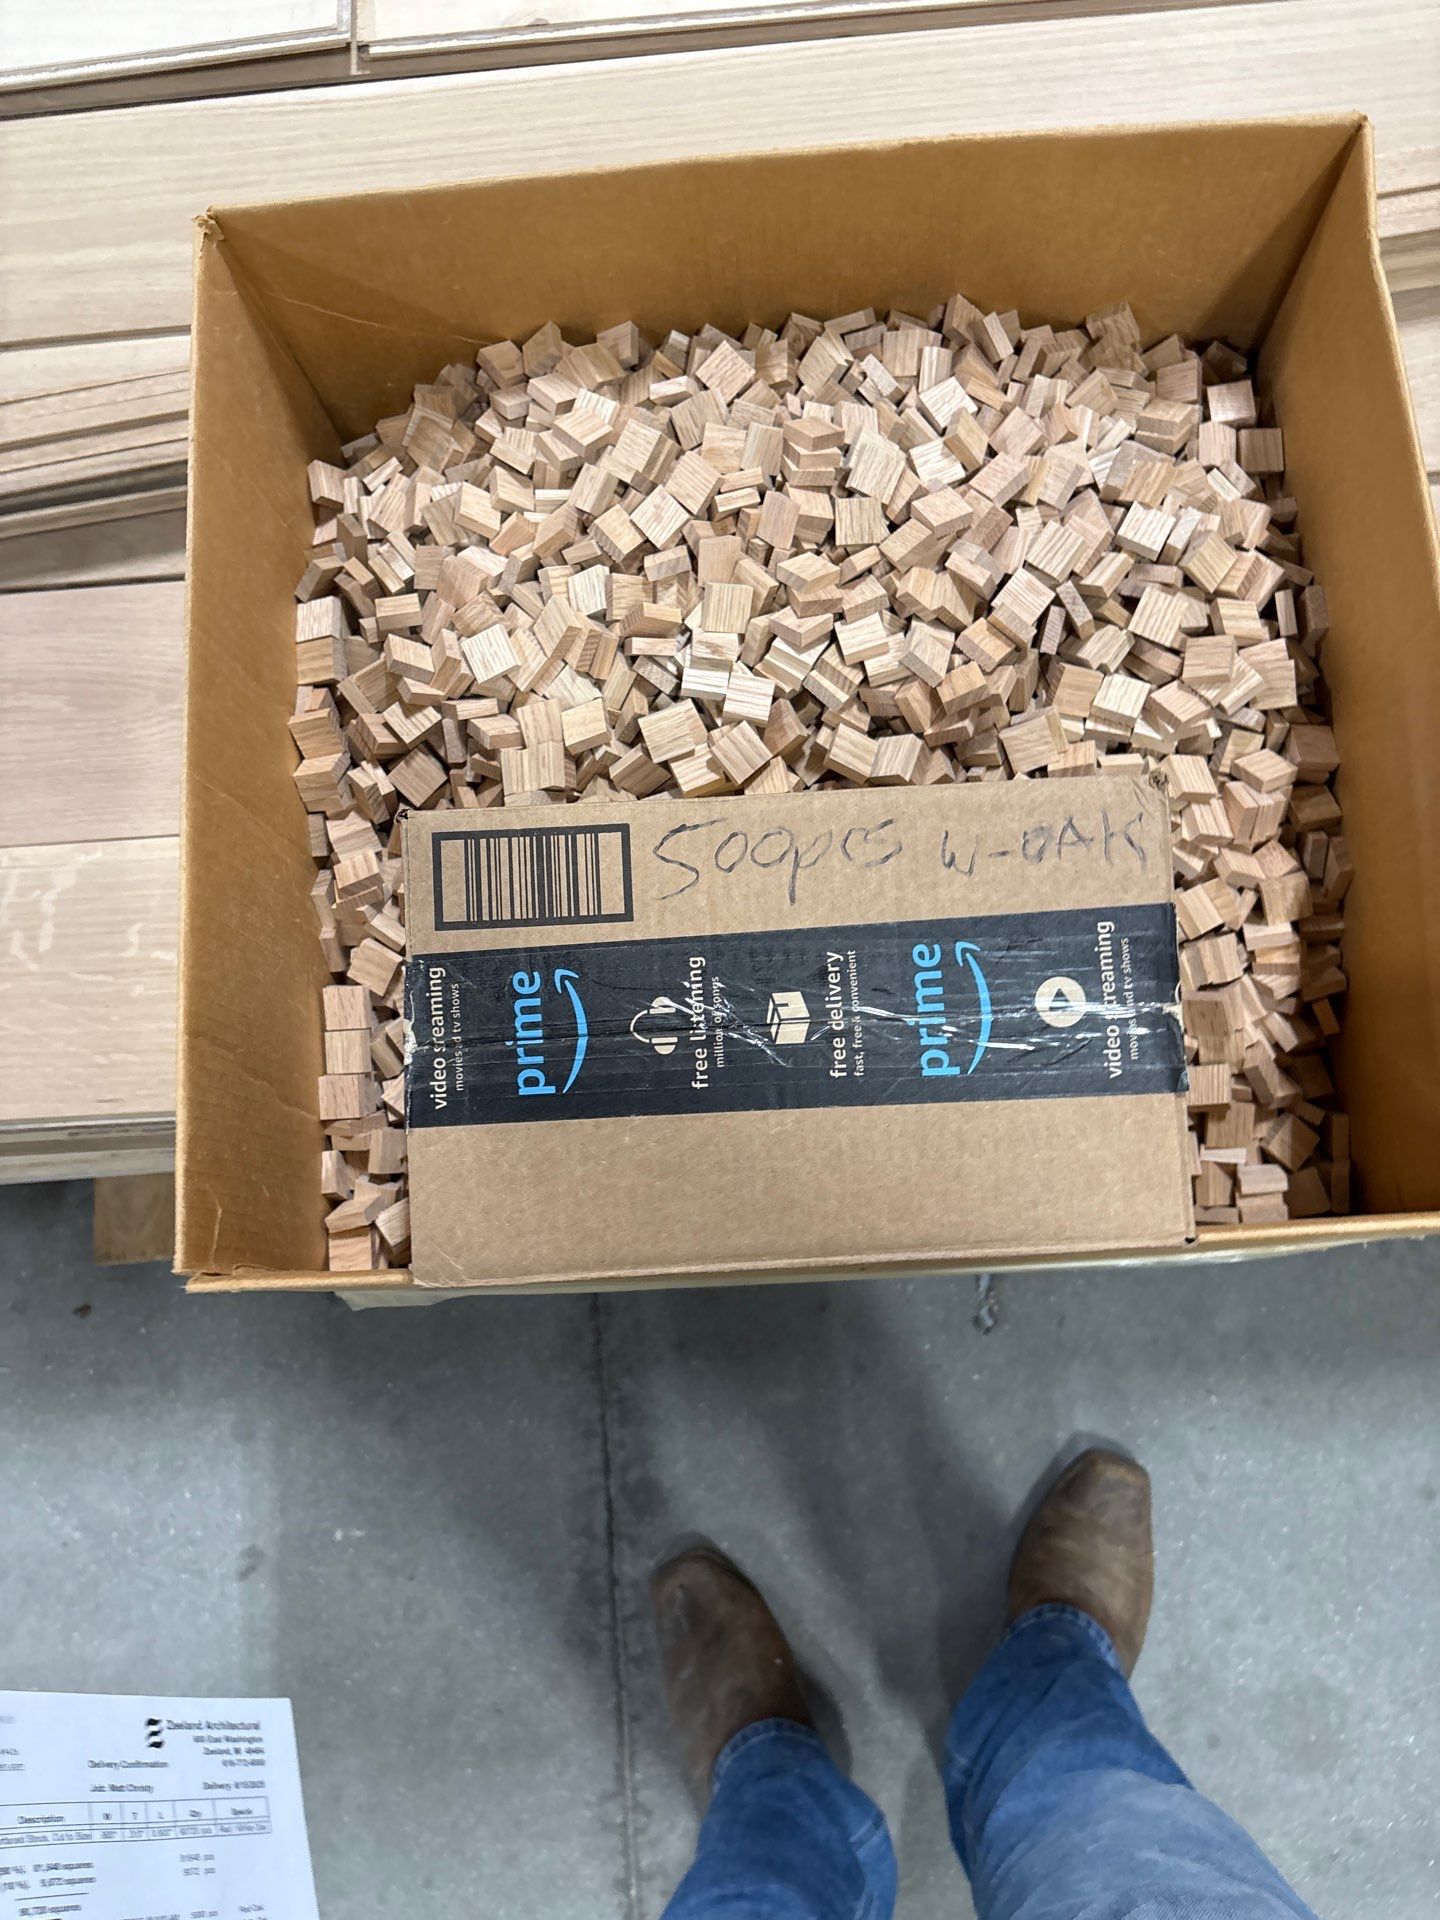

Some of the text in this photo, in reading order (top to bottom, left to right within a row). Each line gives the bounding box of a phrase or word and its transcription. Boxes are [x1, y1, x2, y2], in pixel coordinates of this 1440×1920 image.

[1119, 937, 1132, 974] shows
[450, 983, 461, 1018] shows
[847, 950, 860, 1013] convenient
[452, 1021, 462, 1033] tv
[825, 951, 848, 1079] free delivery
[907, 943, 960, 1078] prime
[505, 971, 557, 1097] prime
[852, 1025, 863, 1049] free
[1102, 1024, 1122, 1079] video
[429, 1057, 447, 1110] video
[452, 1051, 464, 1091] movies
[691, 1048, 709, 1089] free
[853, 1051, 865, 1077] fast,
